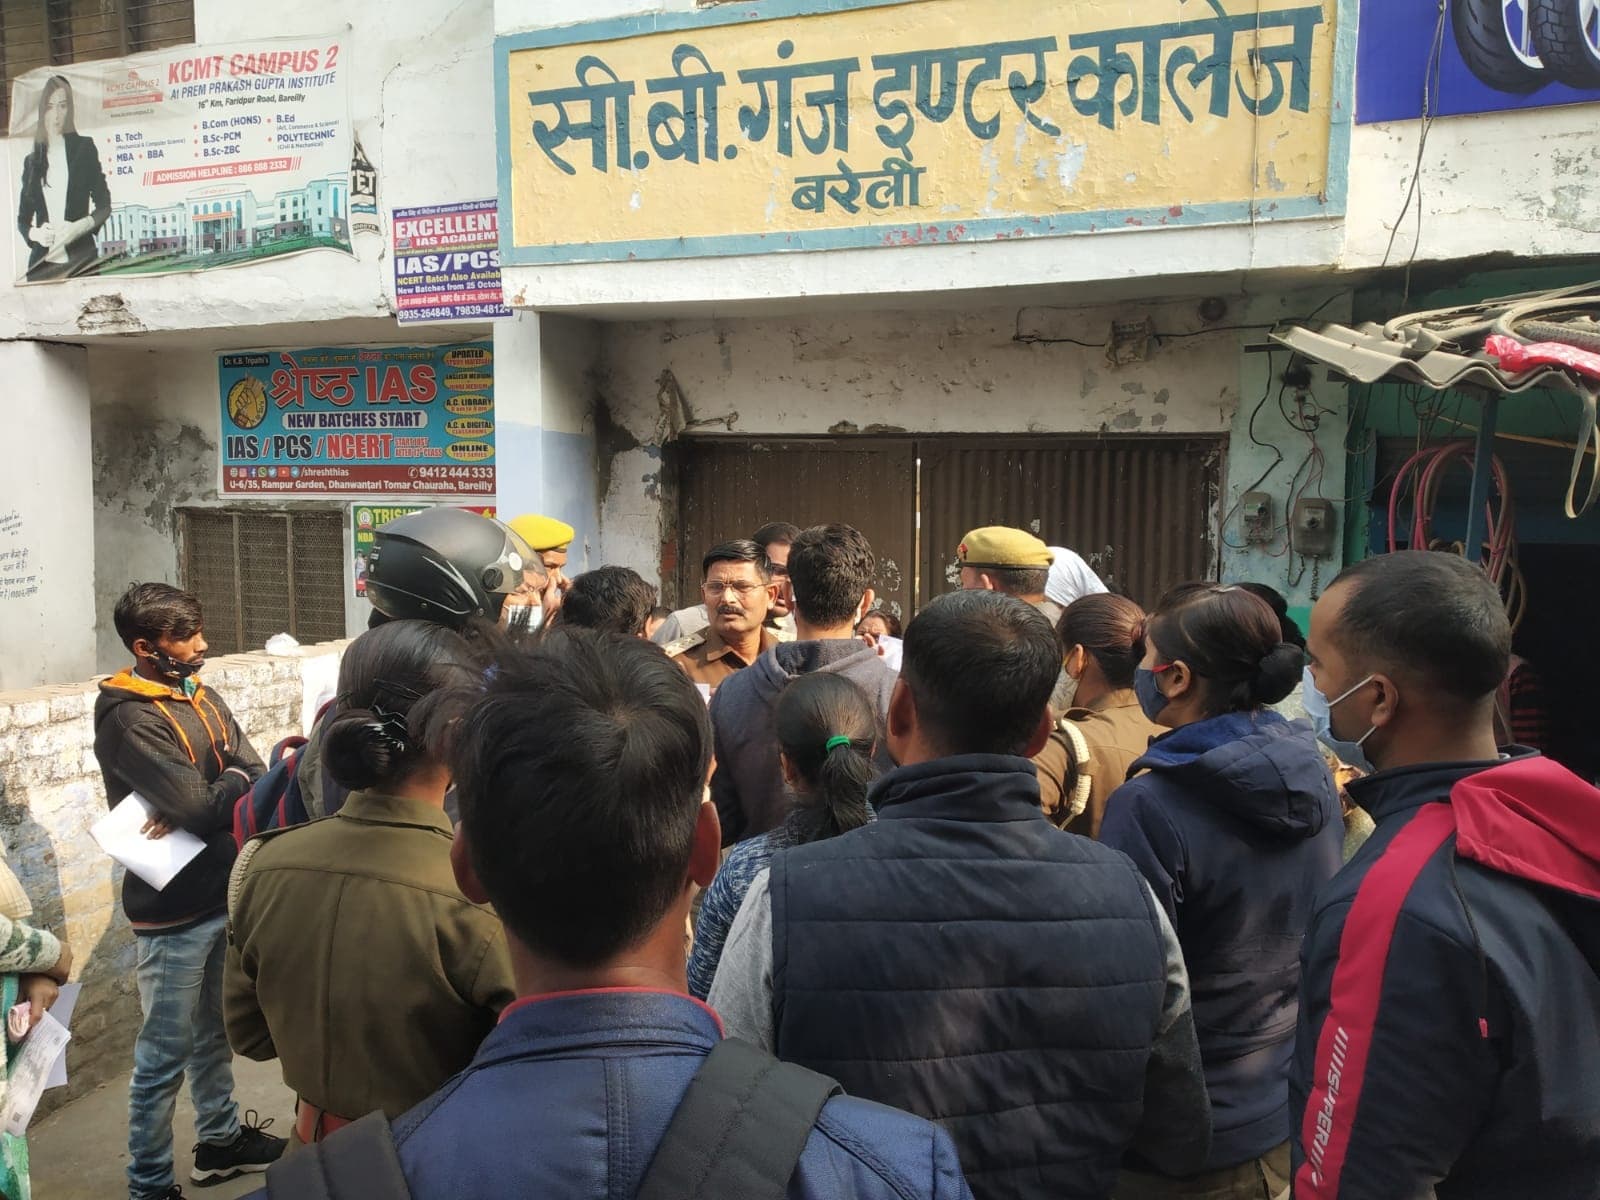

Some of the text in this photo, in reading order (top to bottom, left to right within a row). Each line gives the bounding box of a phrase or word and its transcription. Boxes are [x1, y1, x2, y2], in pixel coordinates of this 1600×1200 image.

[168, 46, 338, 84] KCMT CAMPUS 2
[182, 84, 206, 99] PREM
[209, 79, 251, 94] PRAKASH
[254, 78, 285, 91] GUPTA
[288, 72, 336, 89] INSTITUTE
[226, 96, 255, 108] Faridpur
[256, 94, 276, 104] Road,
[278, 94, 306, 104] Bareilly
[871, 36, 1060, 162] इण्टर
[202, 116, 262, 130] B.Com (HONS)
[276, 114, 295, 123] B.Ed
[125, 132, 142, 141] Tech
[203, 132, 242, 144] B.Sc-PCM
[277, 129, 336, 142] POLYTECHNIC
[116, 153, 134, 162] MBA
[148, 150, 164, 159] BBA
[204, 145, 240, 157] B.Sc-ZBC
[117, 166, 134, 176] BCA
[156, 170, 196, 182] ADMISSION
[269, 160, 288, 170] 2332
[791, 157, 926, 213] बरेली
[416, 236, 438, 246] IAS
[398, 250, 500, 275] IAS/PCS
[398, 270, 501, 286] NCERT Batch Also Availab
[398, 286, 414, 294] New
[416, 284, 446, 292] Batches
[478, 280, 502, 289] Octob
[452, 350, 484, 358] UPDATED
[269, 352, 359, 409] श्रेष्ठ
[366, 364, 438, 403] IAS
[288, 412, 422, 428] NEW BATCHES START
[226, 434, 260, 460] IAS
[273, 434, 313, 460] PCS
[326, 433, 393, 460] NCERT
[424, 448, 443, 457] CLASS
[301, 466, 350, 478] /shreshthias
[420, 466, 494, 478] 9412 444 333
[230, 480, 493, 492] U-6/35, Rampur Garden, Dhanwantari Tomar Chauraha, Bareilly
